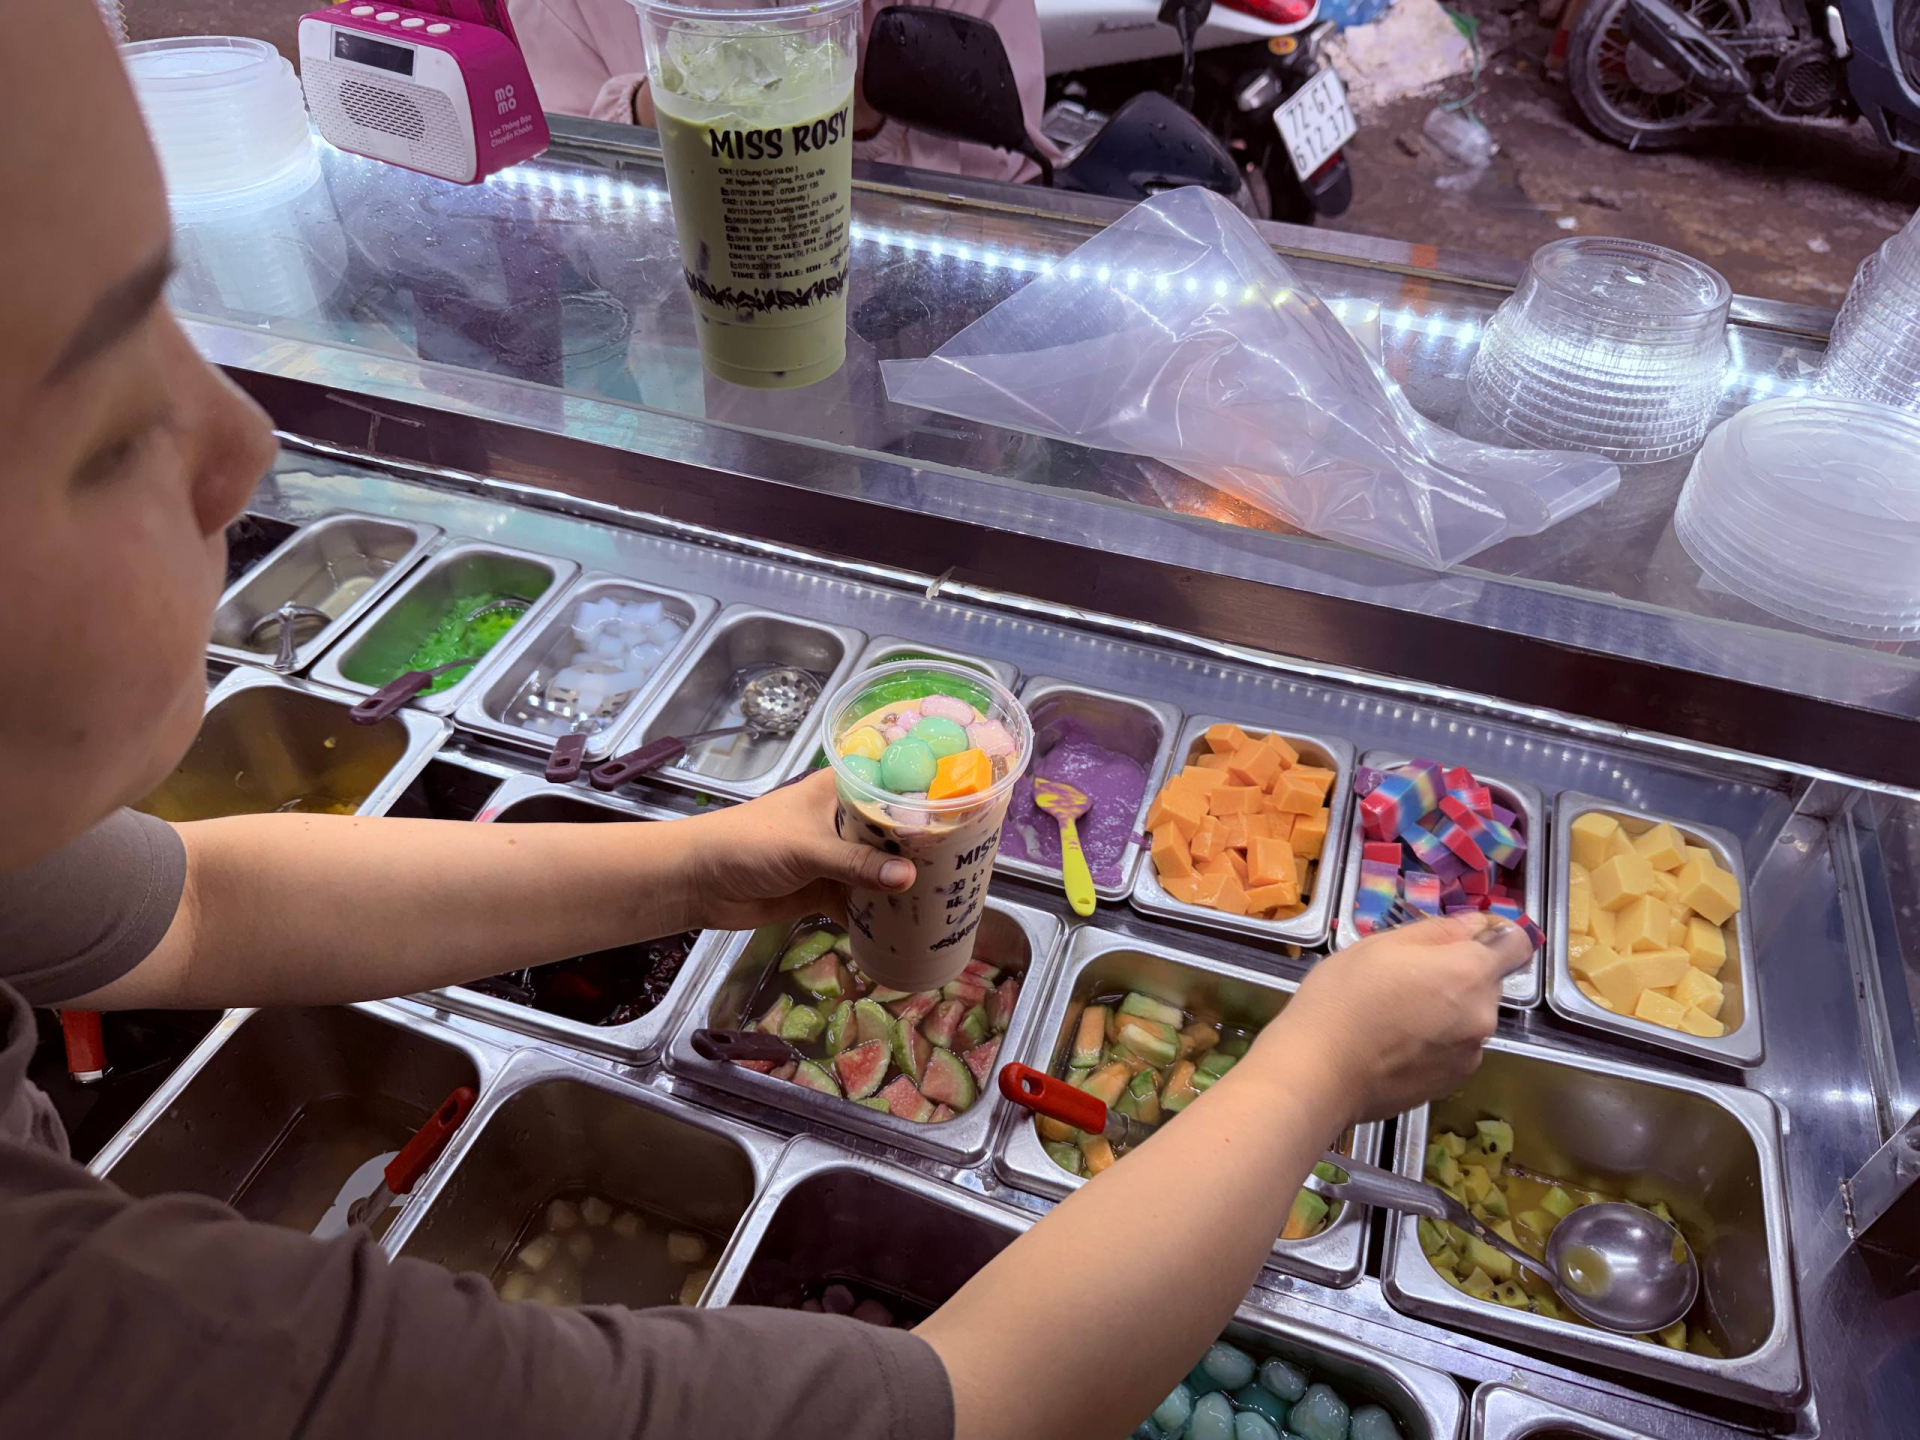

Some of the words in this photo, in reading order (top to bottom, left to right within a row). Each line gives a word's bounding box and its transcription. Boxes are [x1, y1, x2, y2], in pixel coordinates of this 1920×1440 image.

[489, 128, 501, 138] Loa
[709, 128, 783, 160] MISS
[792, 106, 848, 156] ROSY
[728, 242, 752, 252] TIME
[773, 240, 801, 250] SALE:
[732, 271, 756, 279] TIME
[759, 271, 771, 279] OF
[776, 269, 803, 278] SALE:
[955, 828, 1000, 870] MISS
